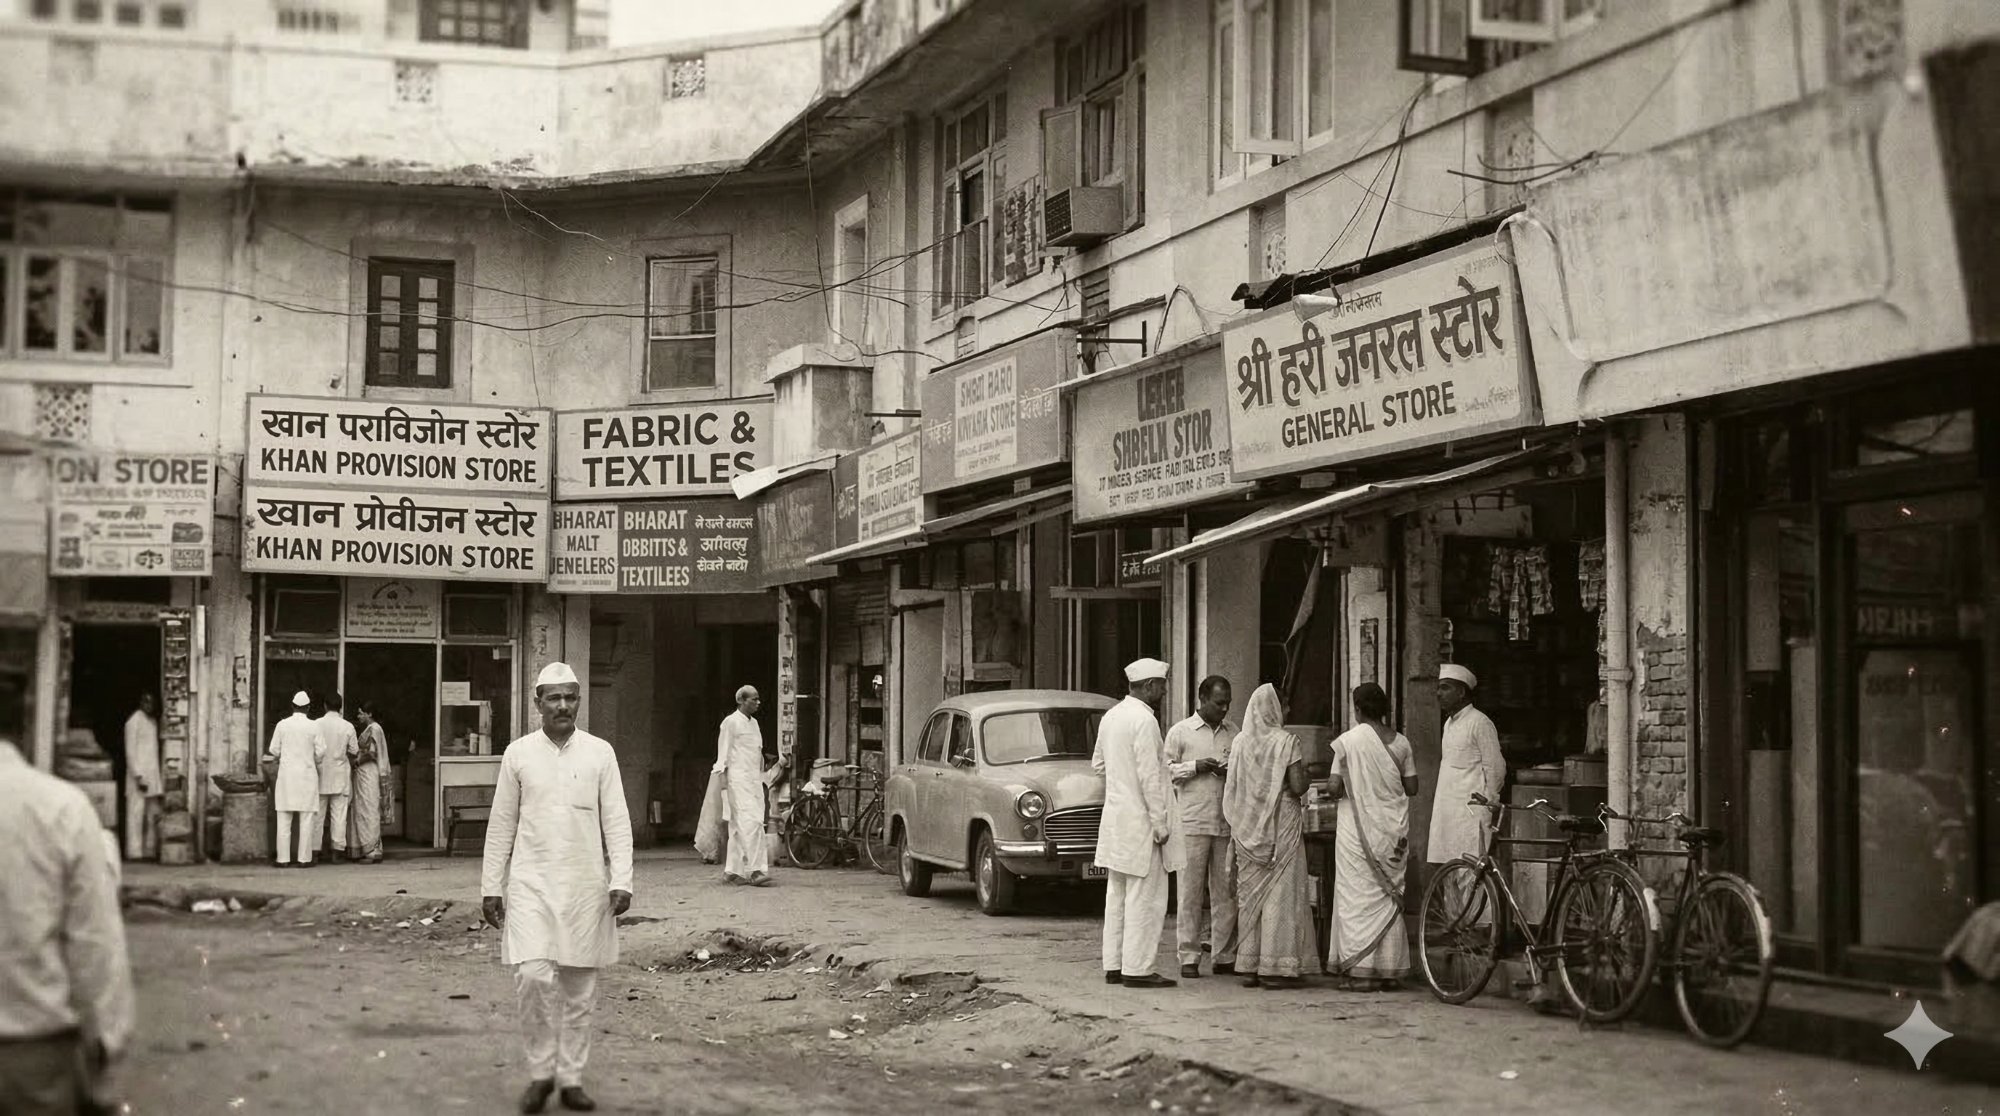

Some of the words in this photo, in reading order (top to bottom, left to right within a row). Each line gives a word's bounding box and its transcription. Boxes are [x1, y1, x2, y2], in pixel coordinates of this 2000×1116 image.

[1237, 337, 1273, 411] श्री
[1278, 321, 1327, 407] हरी
[1331, 309, 1425, 388] जनरल
[1429, 275, 1503, 363] स्टोर
[261, 410, 329, 438] खान
[476, 412, 540, 450] स्टोर
[583, 412, 719, 450] FABRIC
[730, 411, 755, 444] &
[990, 400, 1016, 433] STORE
[1281, 401, 1375, 448] GENERAL
[1382, 381, 1456, 427] STORE
[1174, 408, 1213, 459] STOR
[115, 458, 208, 484] STORE
[261, 448, 327, 473] KHAN
[336, 451, 456, 479] PROVISION
[465, 457, 537, 483] STORE
[582, 451, 755, 487] TEXTILES
[257, 499, 345, 528] खान
[354, 495, 469, 534] प्रोवीजन
[475, 501, 538, 538] स्टोर
[553, 510, 615, 530] BHARAT
[624, 510, 688, 530] BHARAT
[256, 536, 322, 561] KHAN
[331, 539, 452, 567] PROVISION
[462, 545, 534, 570] STORE
[567, 535, 599, 552] MALT
[621, 566, 690, 587] TEXTILEES
